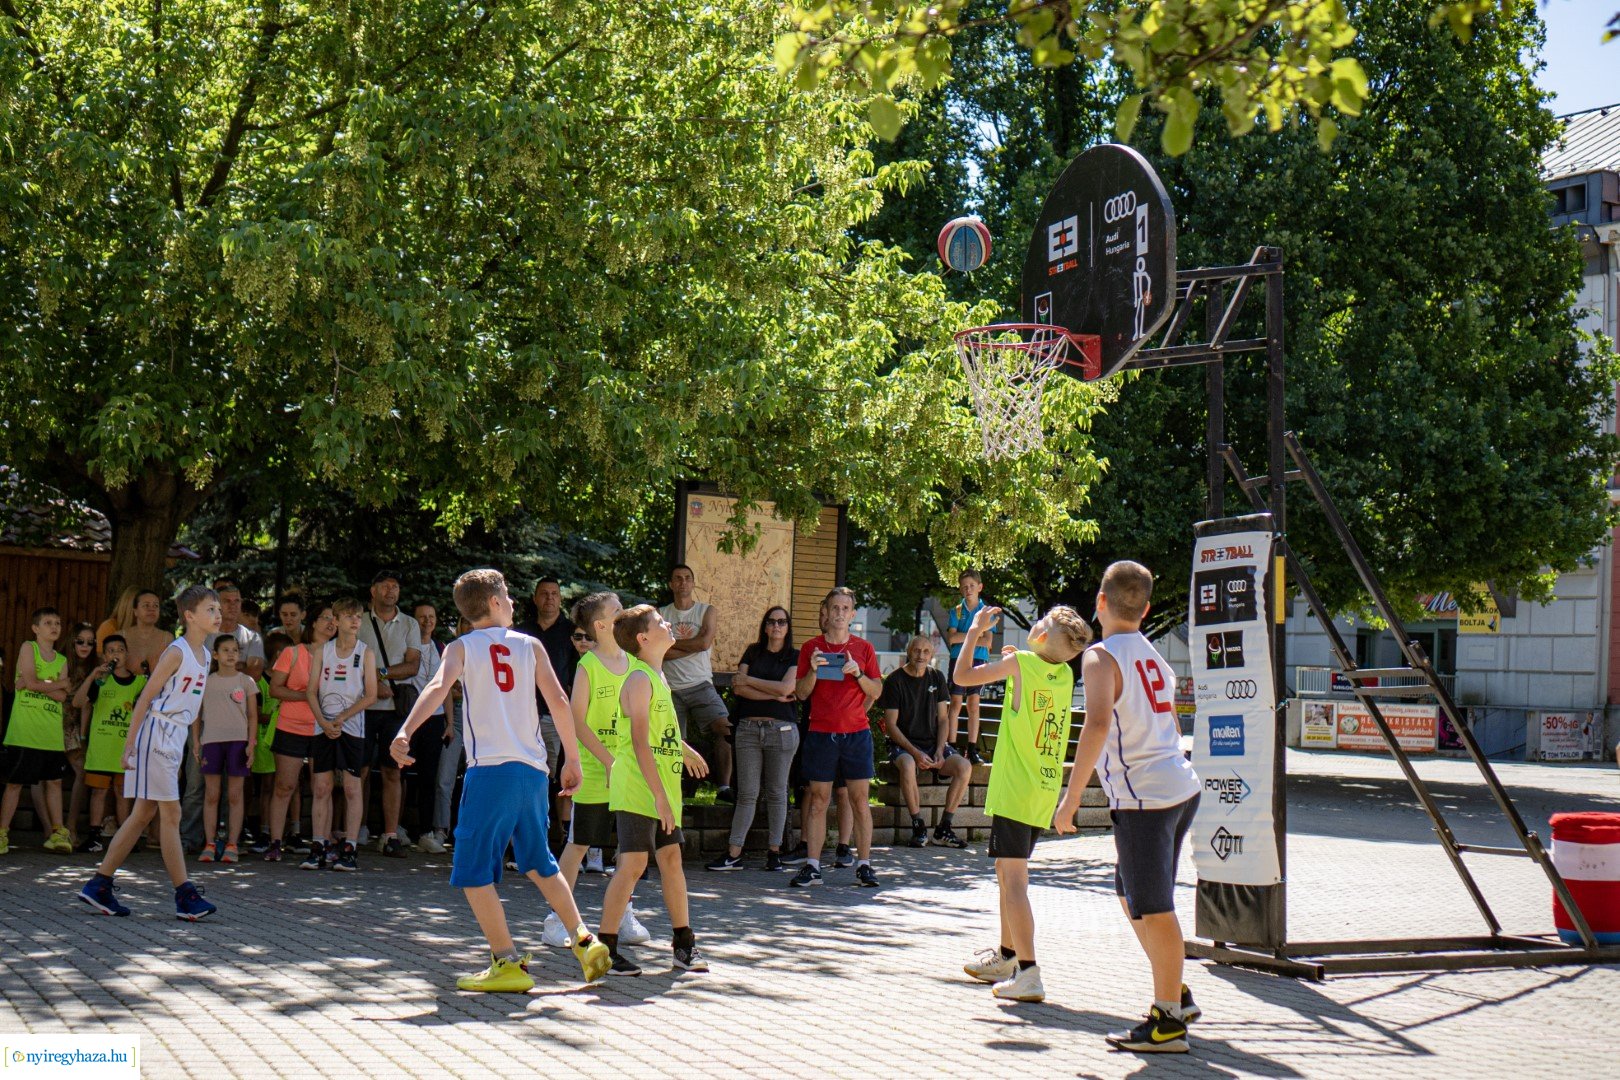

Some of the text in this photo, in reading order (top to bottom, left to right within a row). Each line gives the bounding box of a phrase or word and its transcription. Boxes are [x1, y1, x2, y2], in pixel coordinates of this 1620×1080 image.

[1138, 216, 1146, 243] 1
[1105, 232, 1119, 243] Audi
[1105, 241, 1130, 255] Hungaria
[490, 644, 514, 692] 6
[182, 676, 192, 693] 7
[1135, 659, 1172, 713] 12
[1360, 716, 1433, 726] HEIKRISTÁLY
[1212, 726, 1241, 738] molten
[1205, 778, 1242, 792] POWER
[1219, 792, 1242, 804] ADE
